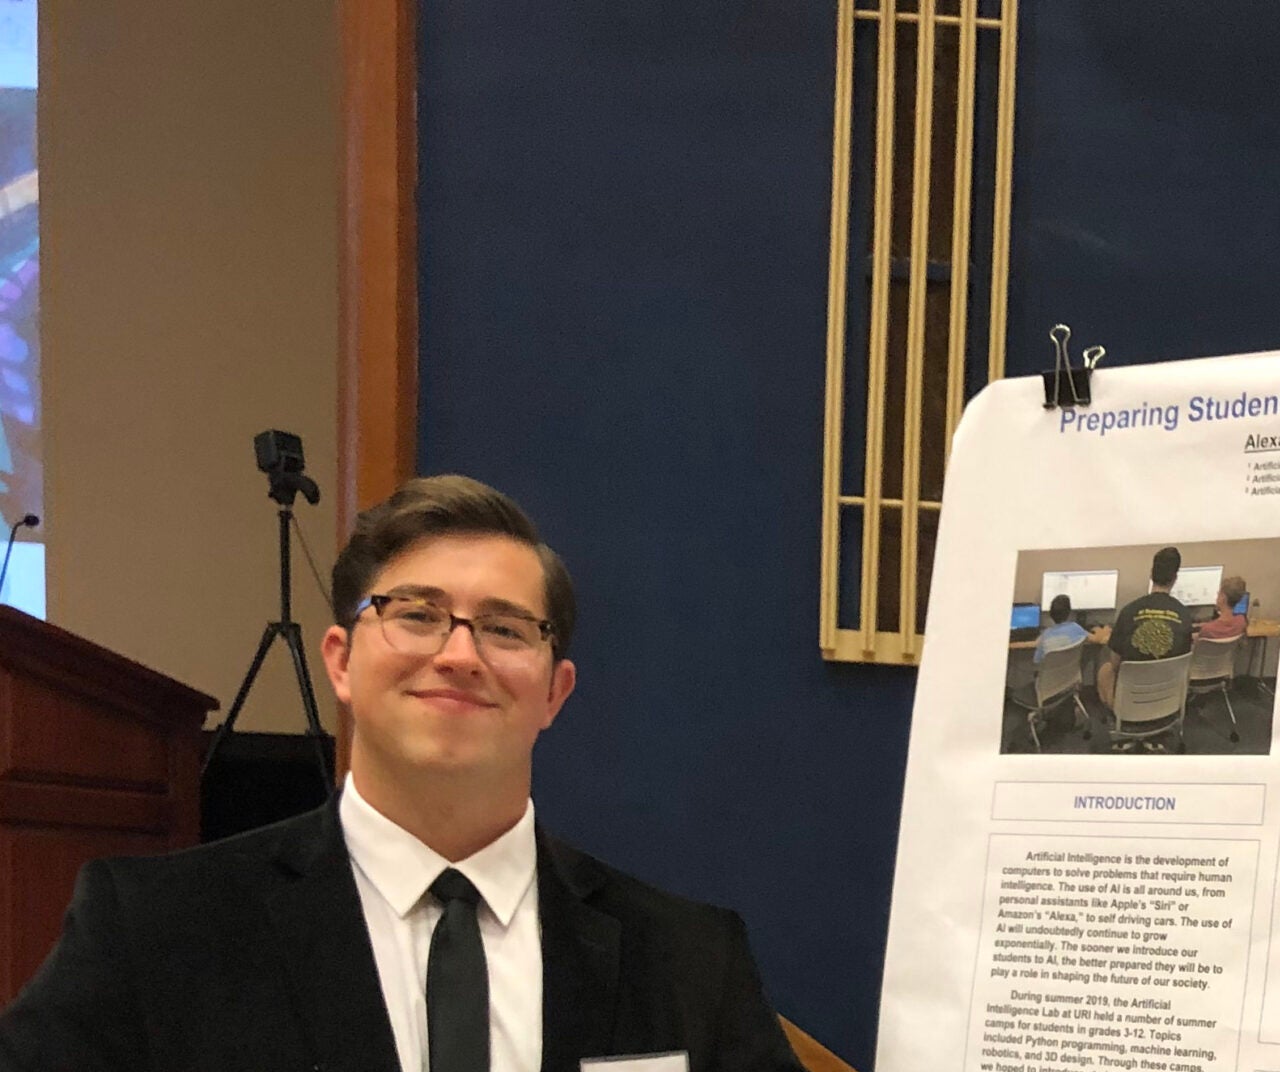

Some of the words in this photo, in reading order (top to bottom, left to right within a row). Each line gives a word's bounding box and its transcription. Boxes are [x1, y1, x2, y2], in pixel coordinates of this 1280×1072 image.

[1060, 403, 1179, 436] Preparing
[1073, 795, 1176, 810] INTRODUCTION
[1025, 851, 1065, 862] Artificial
[1066, 852, 1122, 866] Intelligence
[1123, 854, 1133, 865] is
[1135, 854, 1151, 865] the
[1152, 855, 1216, 868] development
[1217, 856, 1229, 867] of
